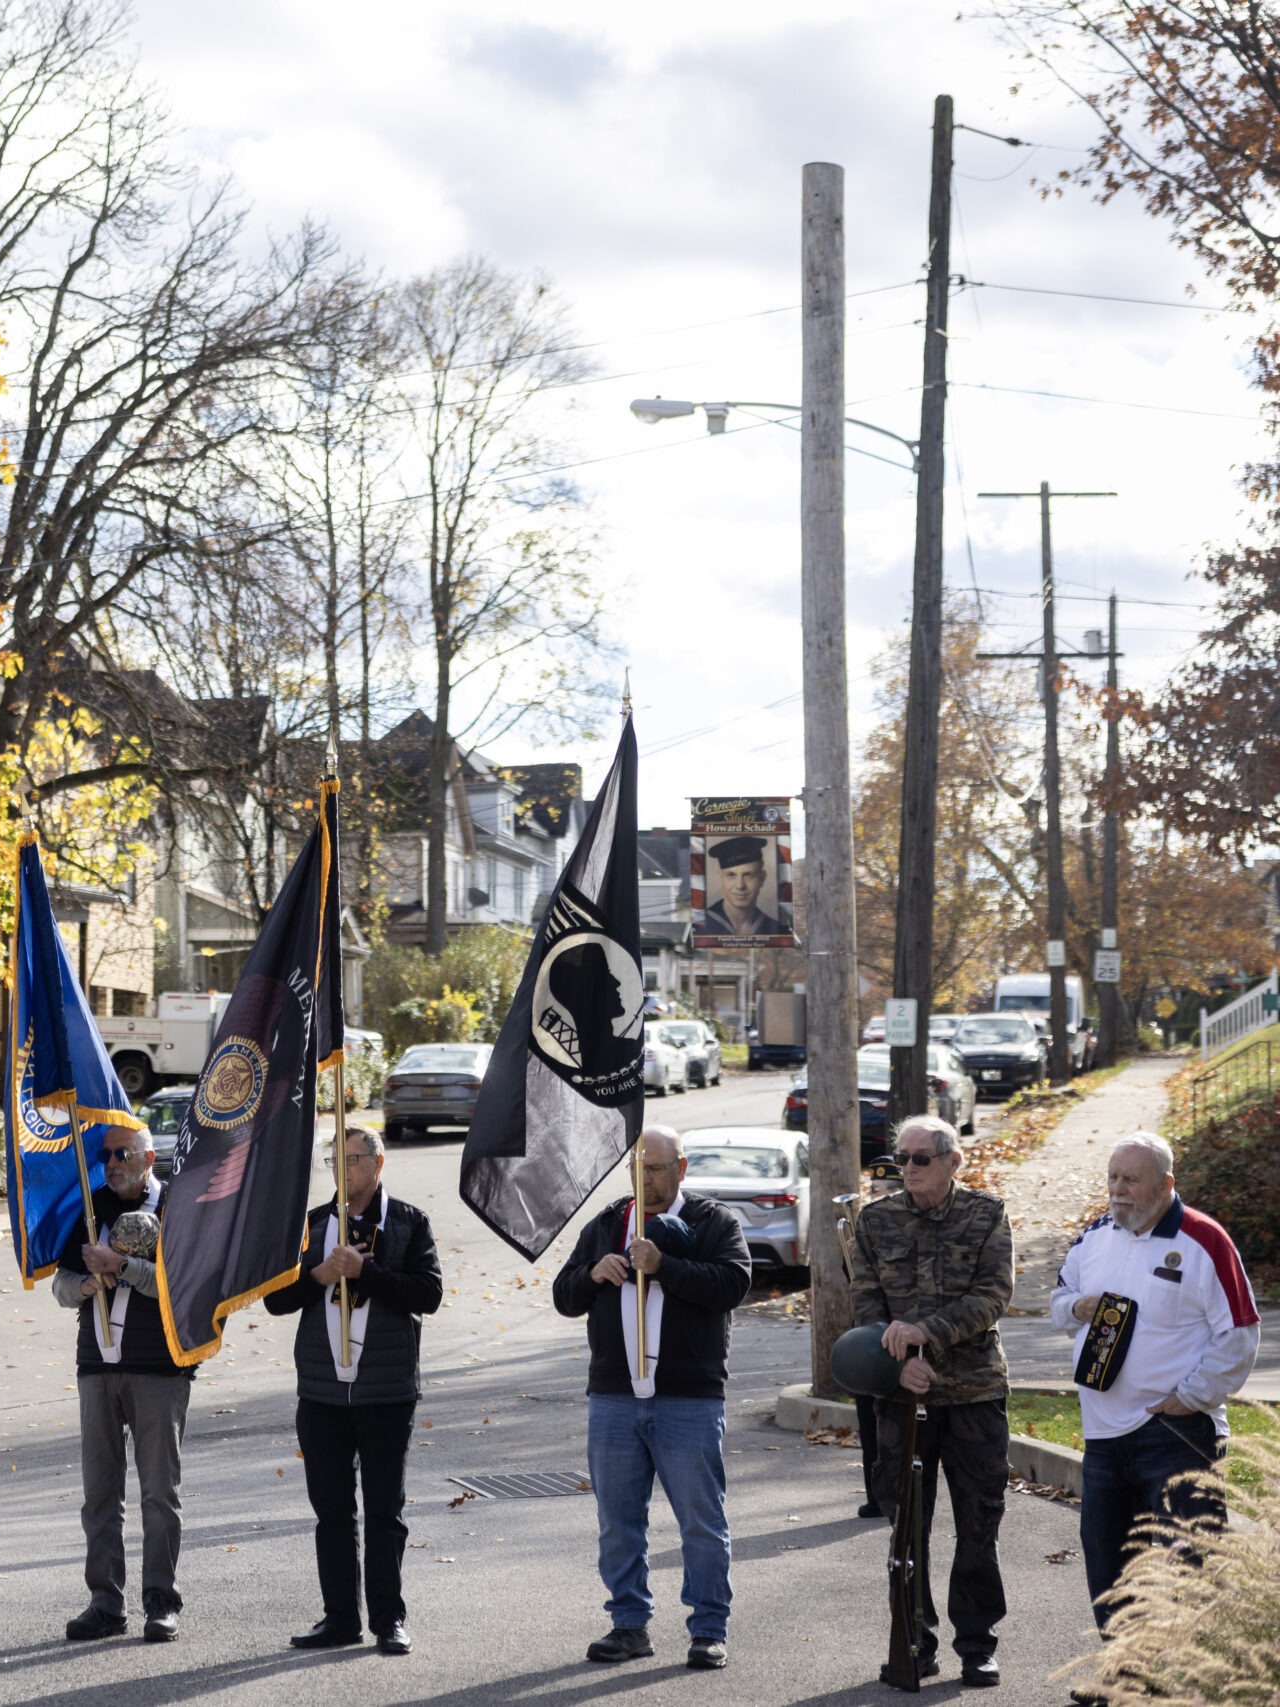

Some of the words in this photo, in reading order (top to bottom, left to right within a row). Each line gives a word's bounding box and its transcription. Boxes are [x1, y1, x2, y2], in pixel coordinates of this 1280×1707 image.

[695, 798, 751, 816] Carnegie
[706, 824, 742, 832] Howard
[744, 824, 776, 832] Schade
[1098, 968, 1118, 980] 25
[896, 1005, 905, 1017] 2
[230, 1045, 262, 1110] AMERICAN
[594, 1086, 616, 1097] YOU
[618, 1077, 638, 1092] ARE
